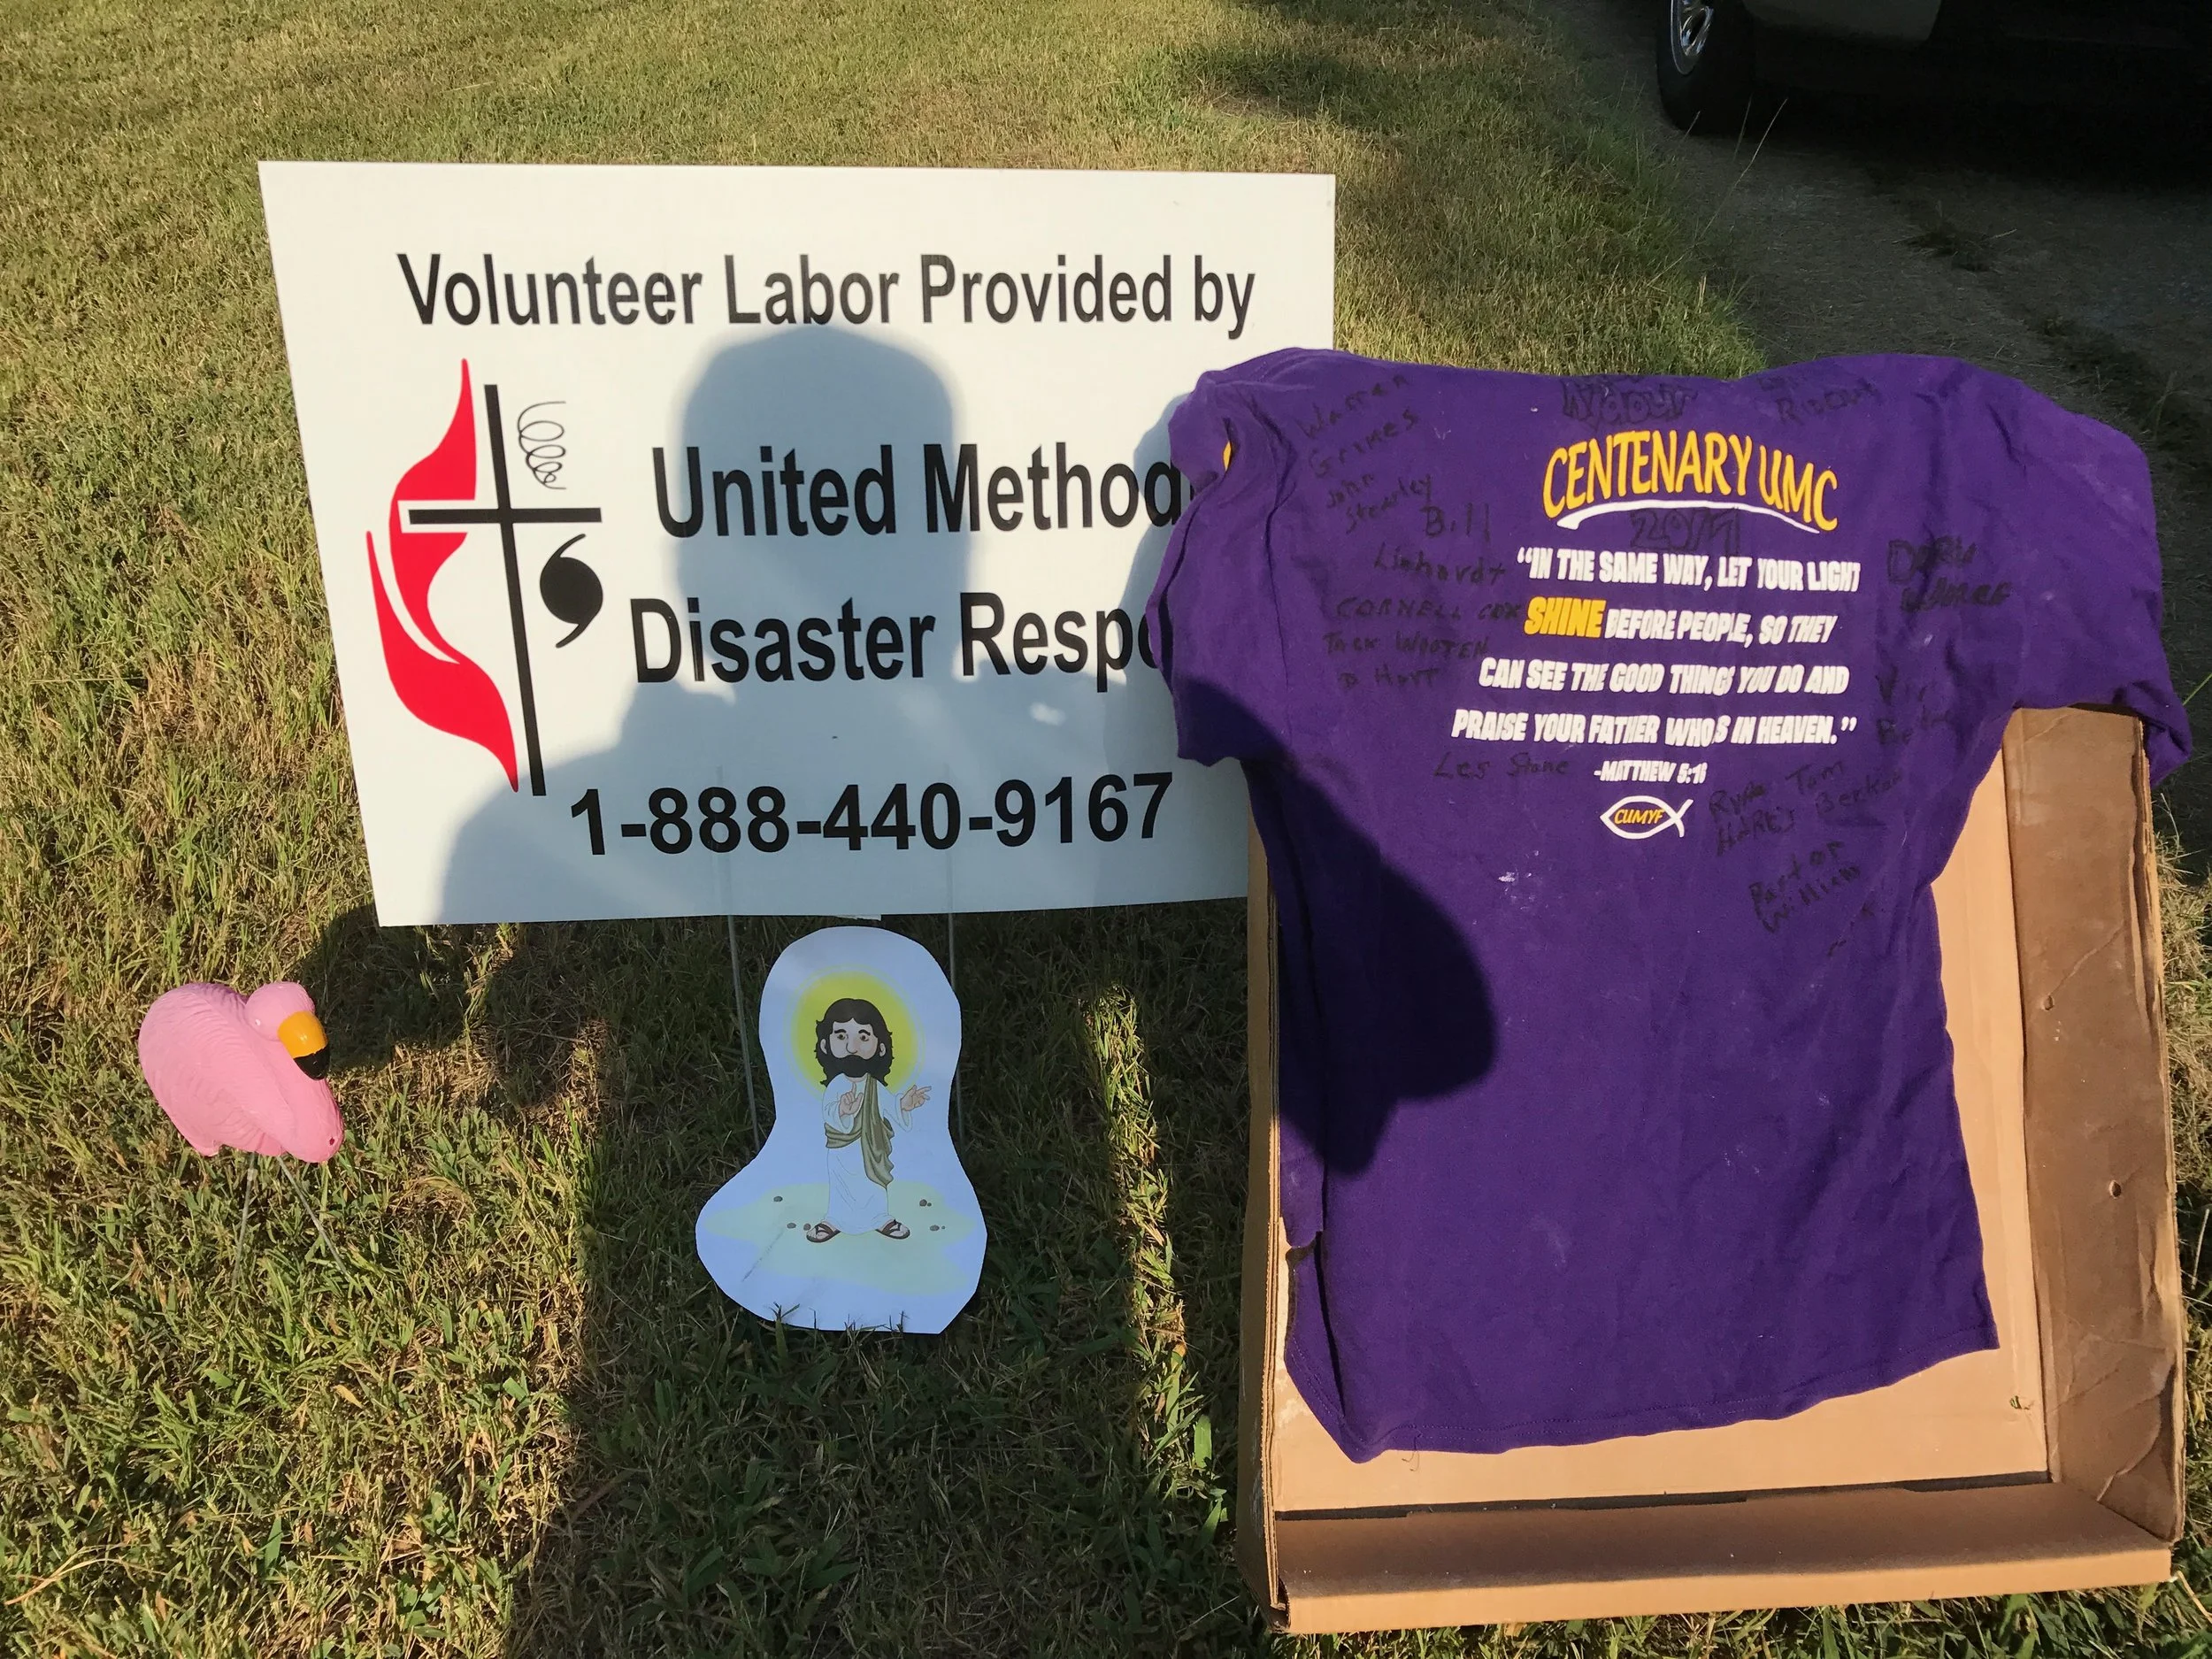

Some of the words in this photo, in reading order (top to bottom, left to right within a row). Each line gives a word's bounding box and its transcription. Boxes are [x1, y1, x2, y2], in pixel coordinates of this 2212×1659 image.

[397, 254, 702, 325] Volunteer
[724, 254, 900, 326] Labor
[922, 255, 1171, 323] Provided
[1195, 256, 1255, 339] by
[653, 444, 896, 538] United
[924, 443, 1194, 532] Method
[1542, 430, 1753, 518] CENTENARY
[1759, 445, 1839, 531] UMC
[1557, 549, 1594, 581] THE
[1599, 551, 1658, 583] SAME
[1663, 554, 1712, 591] WAY,
[1717, 557, 1752, 587] LET
[1757, 558, 1803, 590] YOUR
[1807, 561, 1860, 591] LIGHT
[631, 597, 936, 683] Disaster
[1525, 596, 1606, 638] SHINE
[1606, 609, 1677, 640] BEFORE
[1679, 611, 1753, 648] PEOPLE,
[1759, 615, 1787, 644] SO
[1788, 616, 1838, 642] THEY
[1479, 657, 1525, 688] CAN
[1526, 659, 1568, 690] SEE
[1571, 663, 1609, 691] THE
[1609, 663, 1664, 692] GOOD
[1737, 666, 1778, 693] YOU
[1773, 664, 1804, 693] DO
[1804, 666, 1849, 694] AND
[1451, 710, 1529, 741] PRAISE
[1534, 713, 1586, 743] YOUR
[1588, 715, 1660, 744] FATHER
[1731, 717, 1756, 744] IN
[571, 772, 1173, 856] 1-888-440-9167
[1614, 809, 1664, 825] CUMYF
